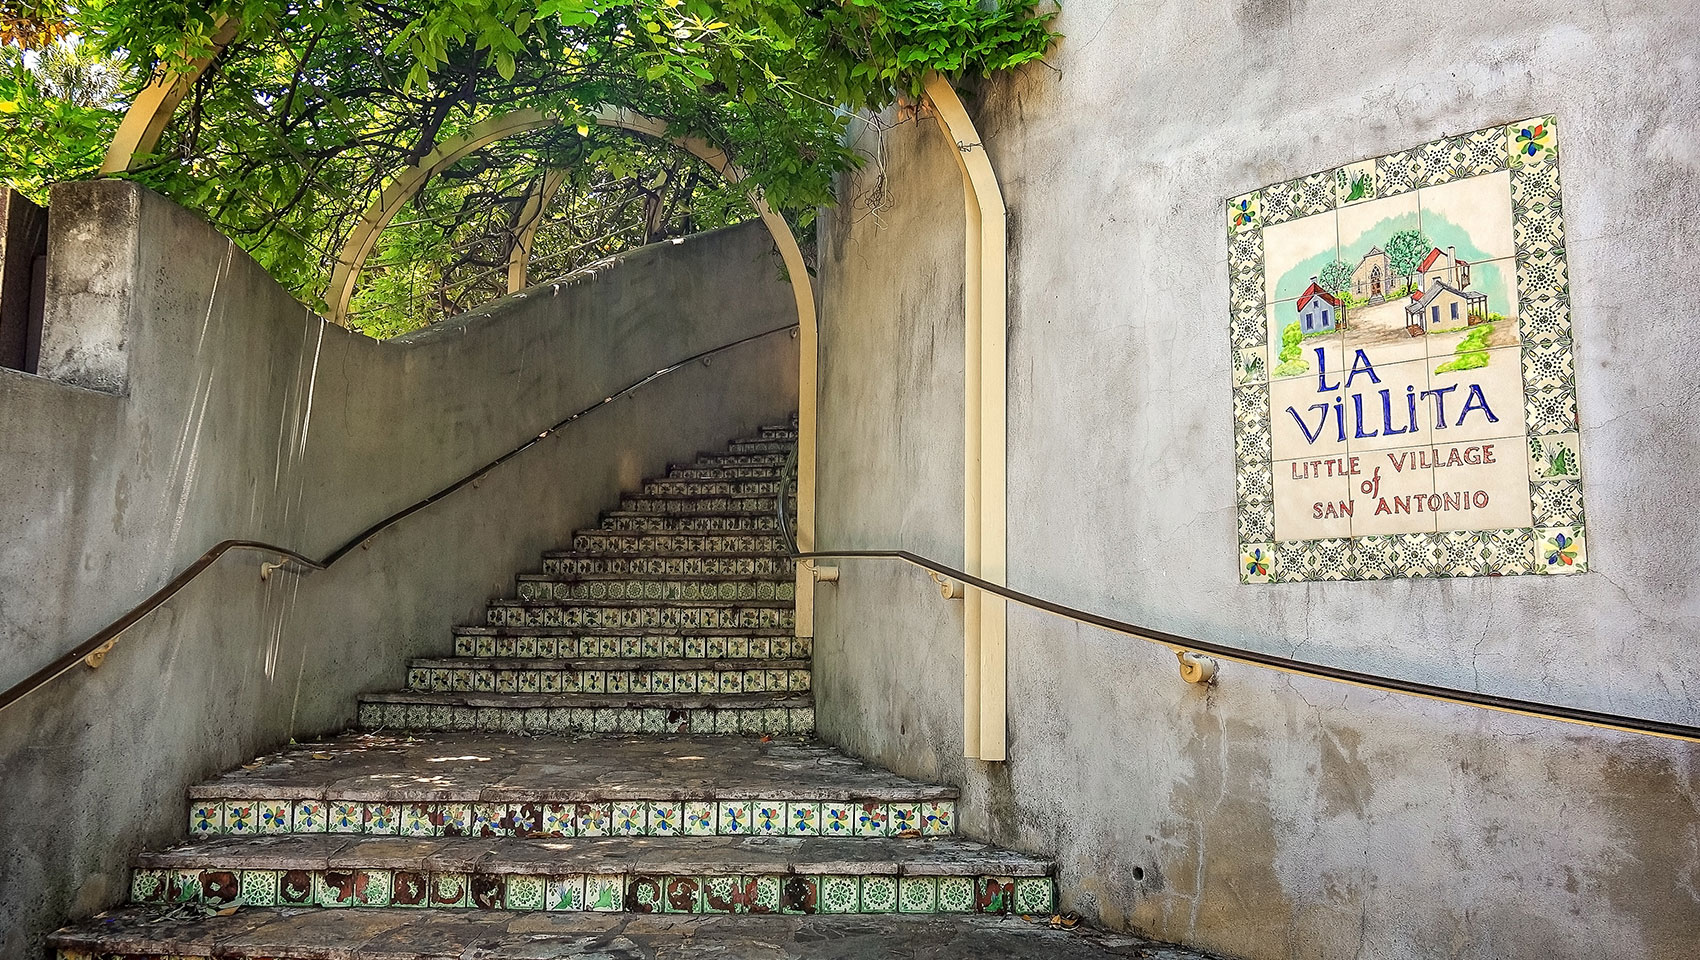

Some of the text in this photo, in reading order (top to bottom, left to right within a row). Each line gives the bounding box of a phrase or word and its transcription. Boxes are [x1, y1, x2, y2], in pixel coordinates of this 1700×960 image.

[1314, 347, 1381, 392] LA
[1291, 444, 1497, 480] LITTLE VILLAGE
[1360, 467, 1381, 499] of
[1313, 490, 1489, 519] SAN ANTONIO
